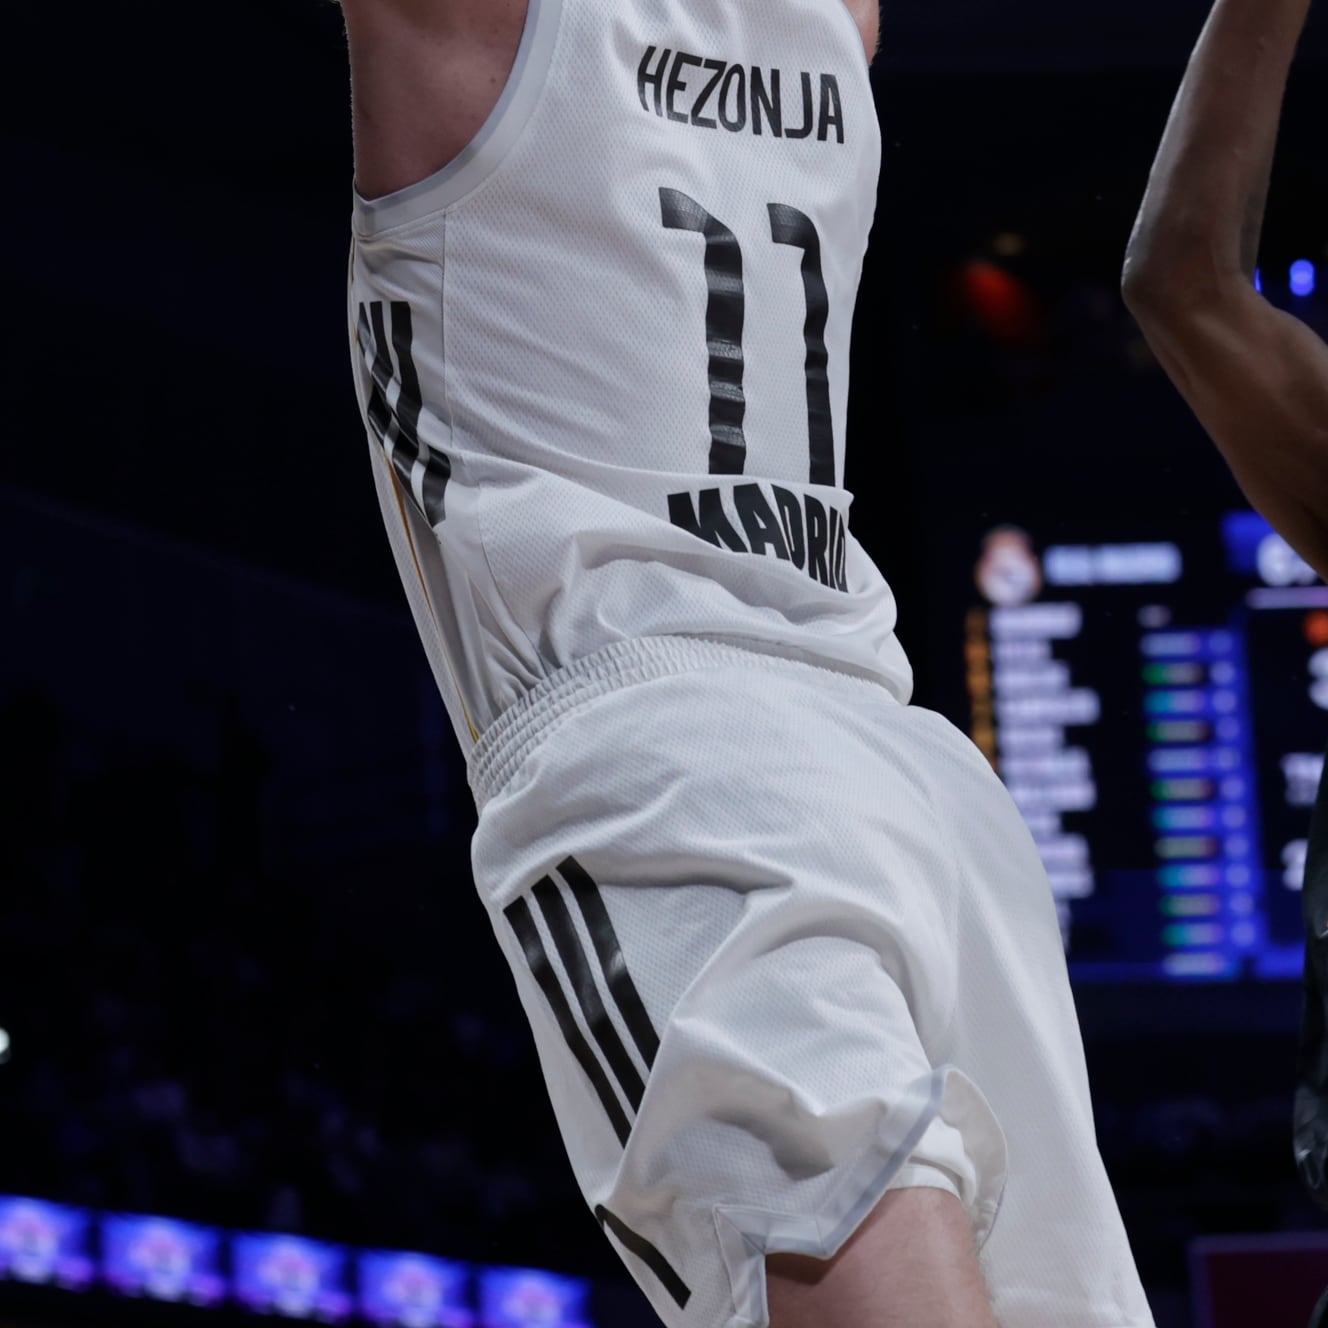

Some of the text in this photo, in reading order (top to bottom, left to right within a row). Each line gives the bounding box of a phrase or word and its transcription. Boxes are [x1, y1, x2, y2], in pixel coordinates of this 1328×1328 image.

[637, 45, 845, 144] HEZONJA
[658, 186, 836, 484] 11
[667, 483, 849, 594] MADRID
